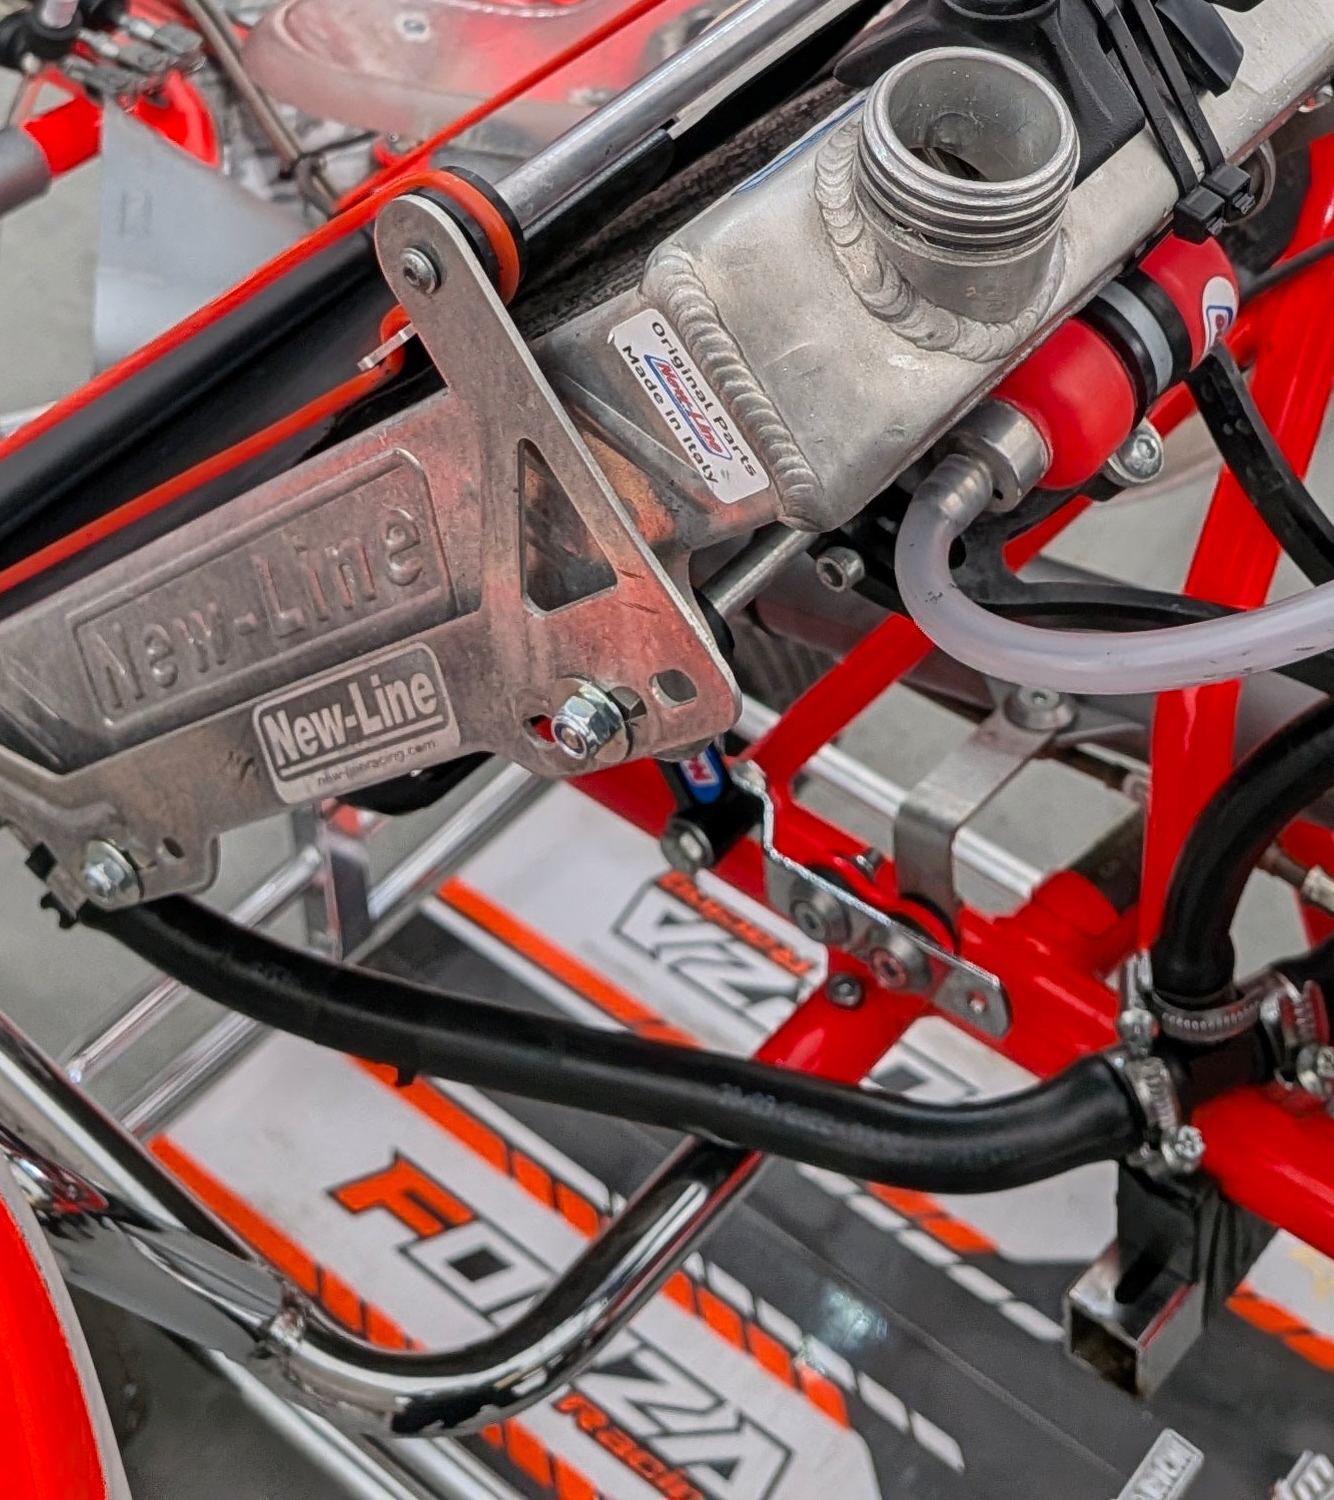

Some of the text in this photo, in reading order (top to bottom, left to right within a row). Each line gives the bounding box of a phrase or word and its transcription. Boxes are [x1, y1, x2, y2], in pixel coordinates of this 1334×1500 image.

[622, 345, 719, 484] Made in Italy
[652, 321, 757, 477] Original Parts
[91, 506, 424, 708] New-Line
[262, 672, 437, 766] New-Line
